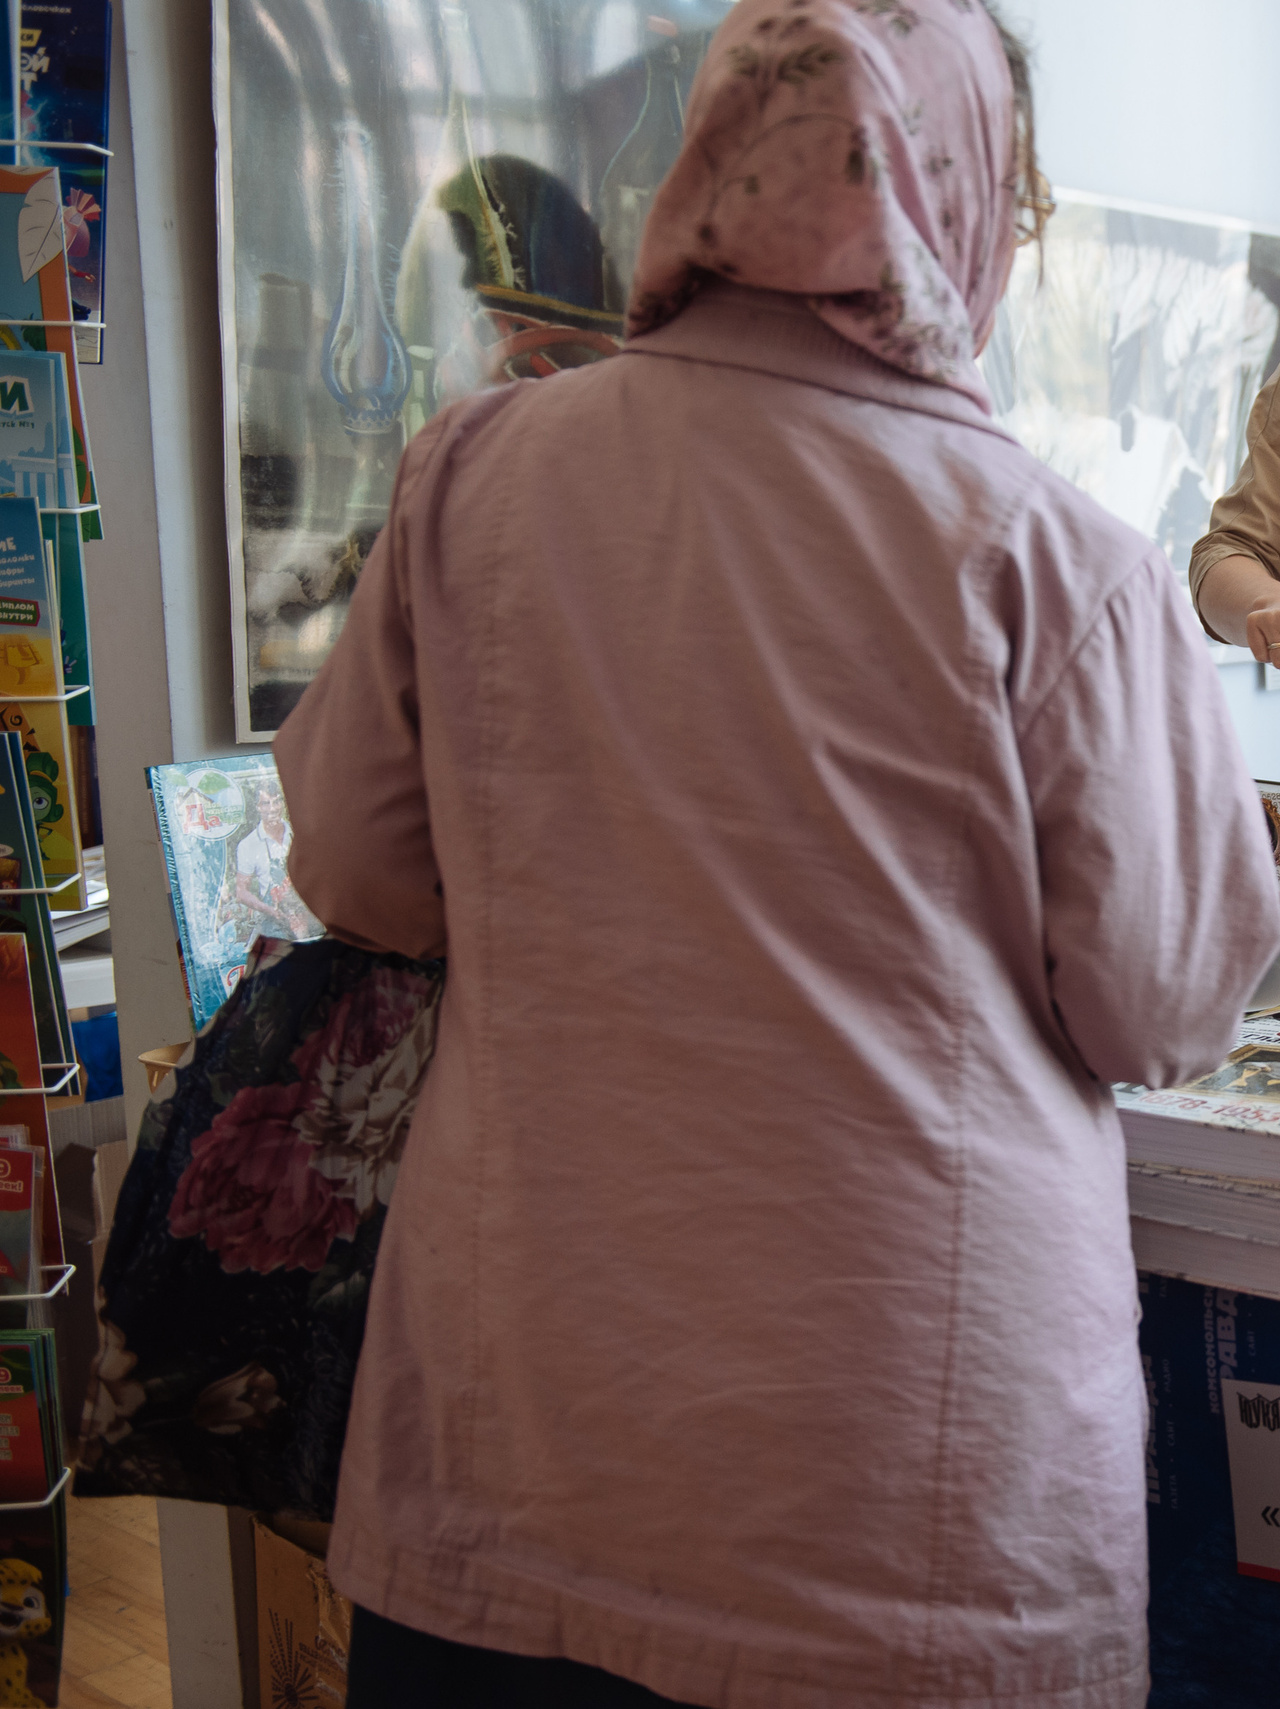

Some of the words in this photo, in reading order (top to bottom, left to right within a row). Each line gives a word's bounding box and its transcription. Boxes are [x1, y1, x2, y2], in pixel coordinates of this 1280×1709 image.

[0, 602, 35, 612] ИПЛОМ
[1203, 1286, 1220, 1413] КОМСОМОЛЬСК
[1216, 1288, 1239, 1379] РАВД
